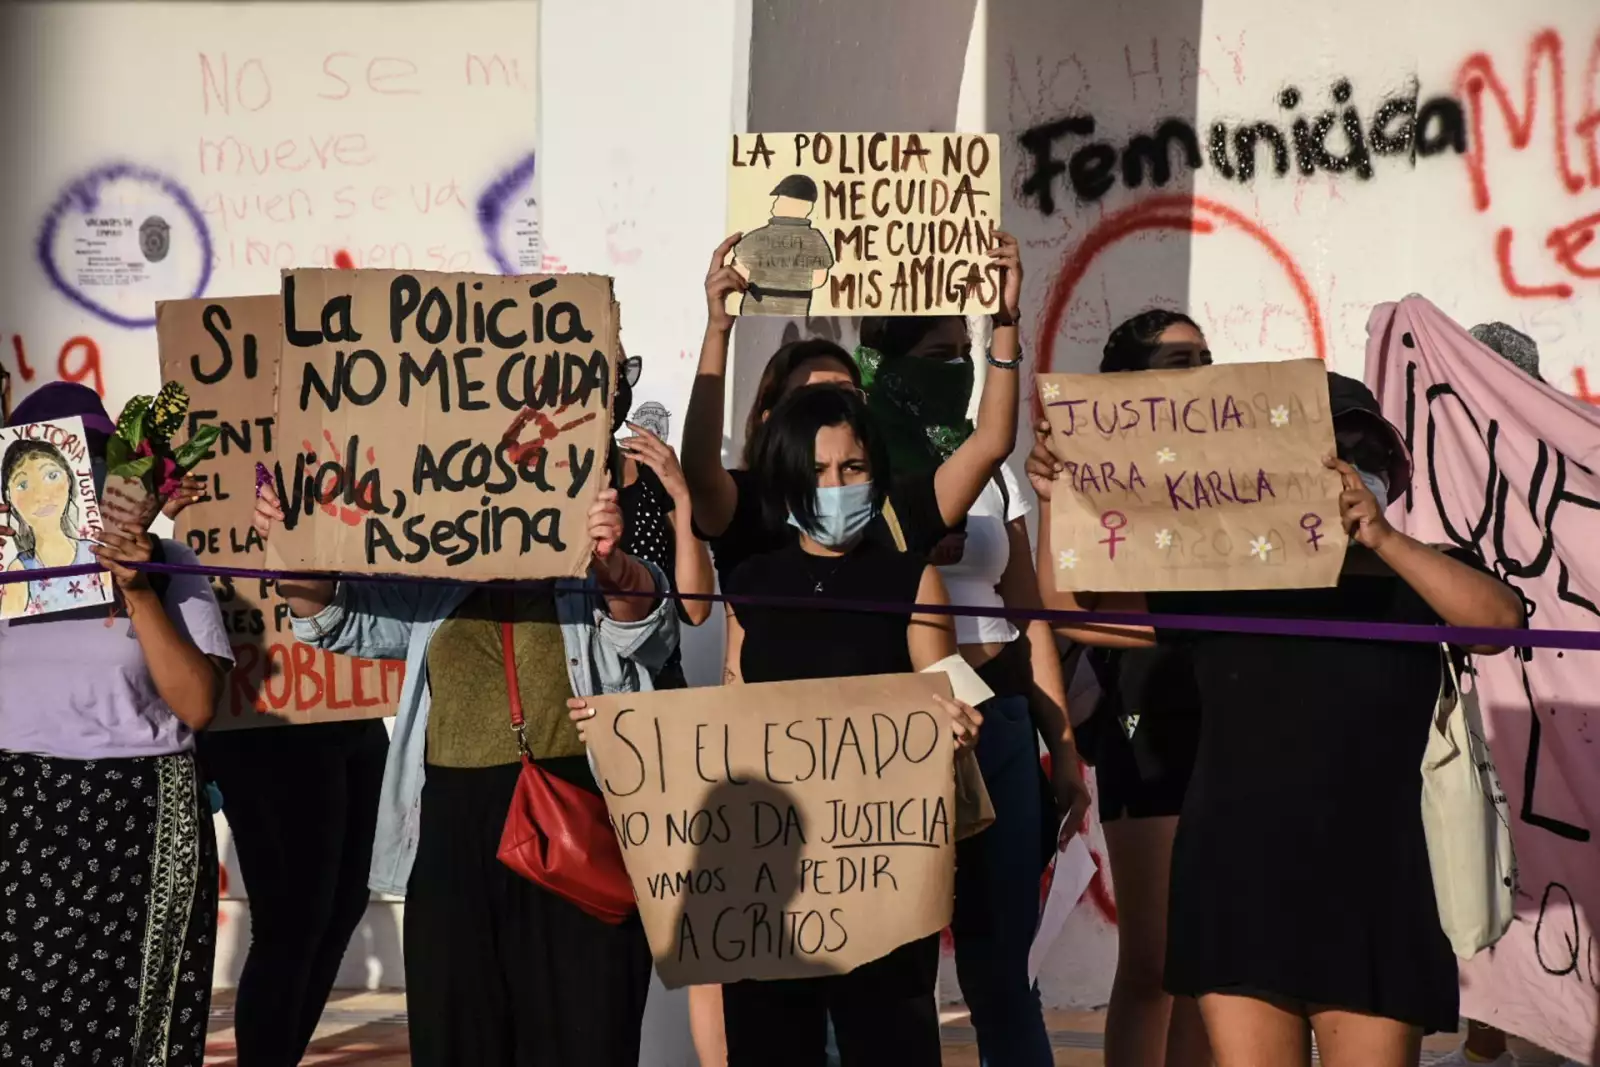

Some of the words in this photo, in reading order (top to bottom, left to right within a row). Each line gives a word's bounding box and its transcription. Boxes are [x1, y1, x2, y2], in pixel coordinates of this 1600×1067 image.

[199, 133, 374, 175] mueve
[732, 133, 775, 168] LA
[795, 132, 931, 174] POLICIA
[943, 135, 989, 178] NO
[824, 179, 866, 220] ME
[834, 225, 878, 263] ME
[886, 216, 994, 258] CUIDAN
[829, 270, 882, 310] MIS
[890, 256, 997, 312] AMIGAS
[284, 275, 362, 347] La
[191, 305, 258, 385] SI
[300, 349, 386, 412] NO
[399, 347, 490, 413] ME
[496, 349, 609, 411] CUIDA
[1048, 395, 1246, 436] JUSTICIA
[12, 423, 86, 463] VICTORIA
[76, 467, 105, 538] JUSTICIA
[1063, 461, 1147, 493] PARA
[1165, 468, 1277, 511] KARLA
[186, 528, 220, 556] DE
[230, 525, 264, 555] LA
[605, 708, 666, 797] SI
[695, 722, 749, 786] EL
[764, 710, 939, 785] ESTADO
[666, 804, 731, 848] NOS
[751, 801, 808, 850] DA
[820, 796, 949, 848] JUSTICIA
[646, 867, 727, 901] VAMOS
[754, 862, 777, 893] A
[800, 854, 899, 895] PEDIR
[678, 911, 700, 963] A
[712, 902, 849, 963] GRITOS
